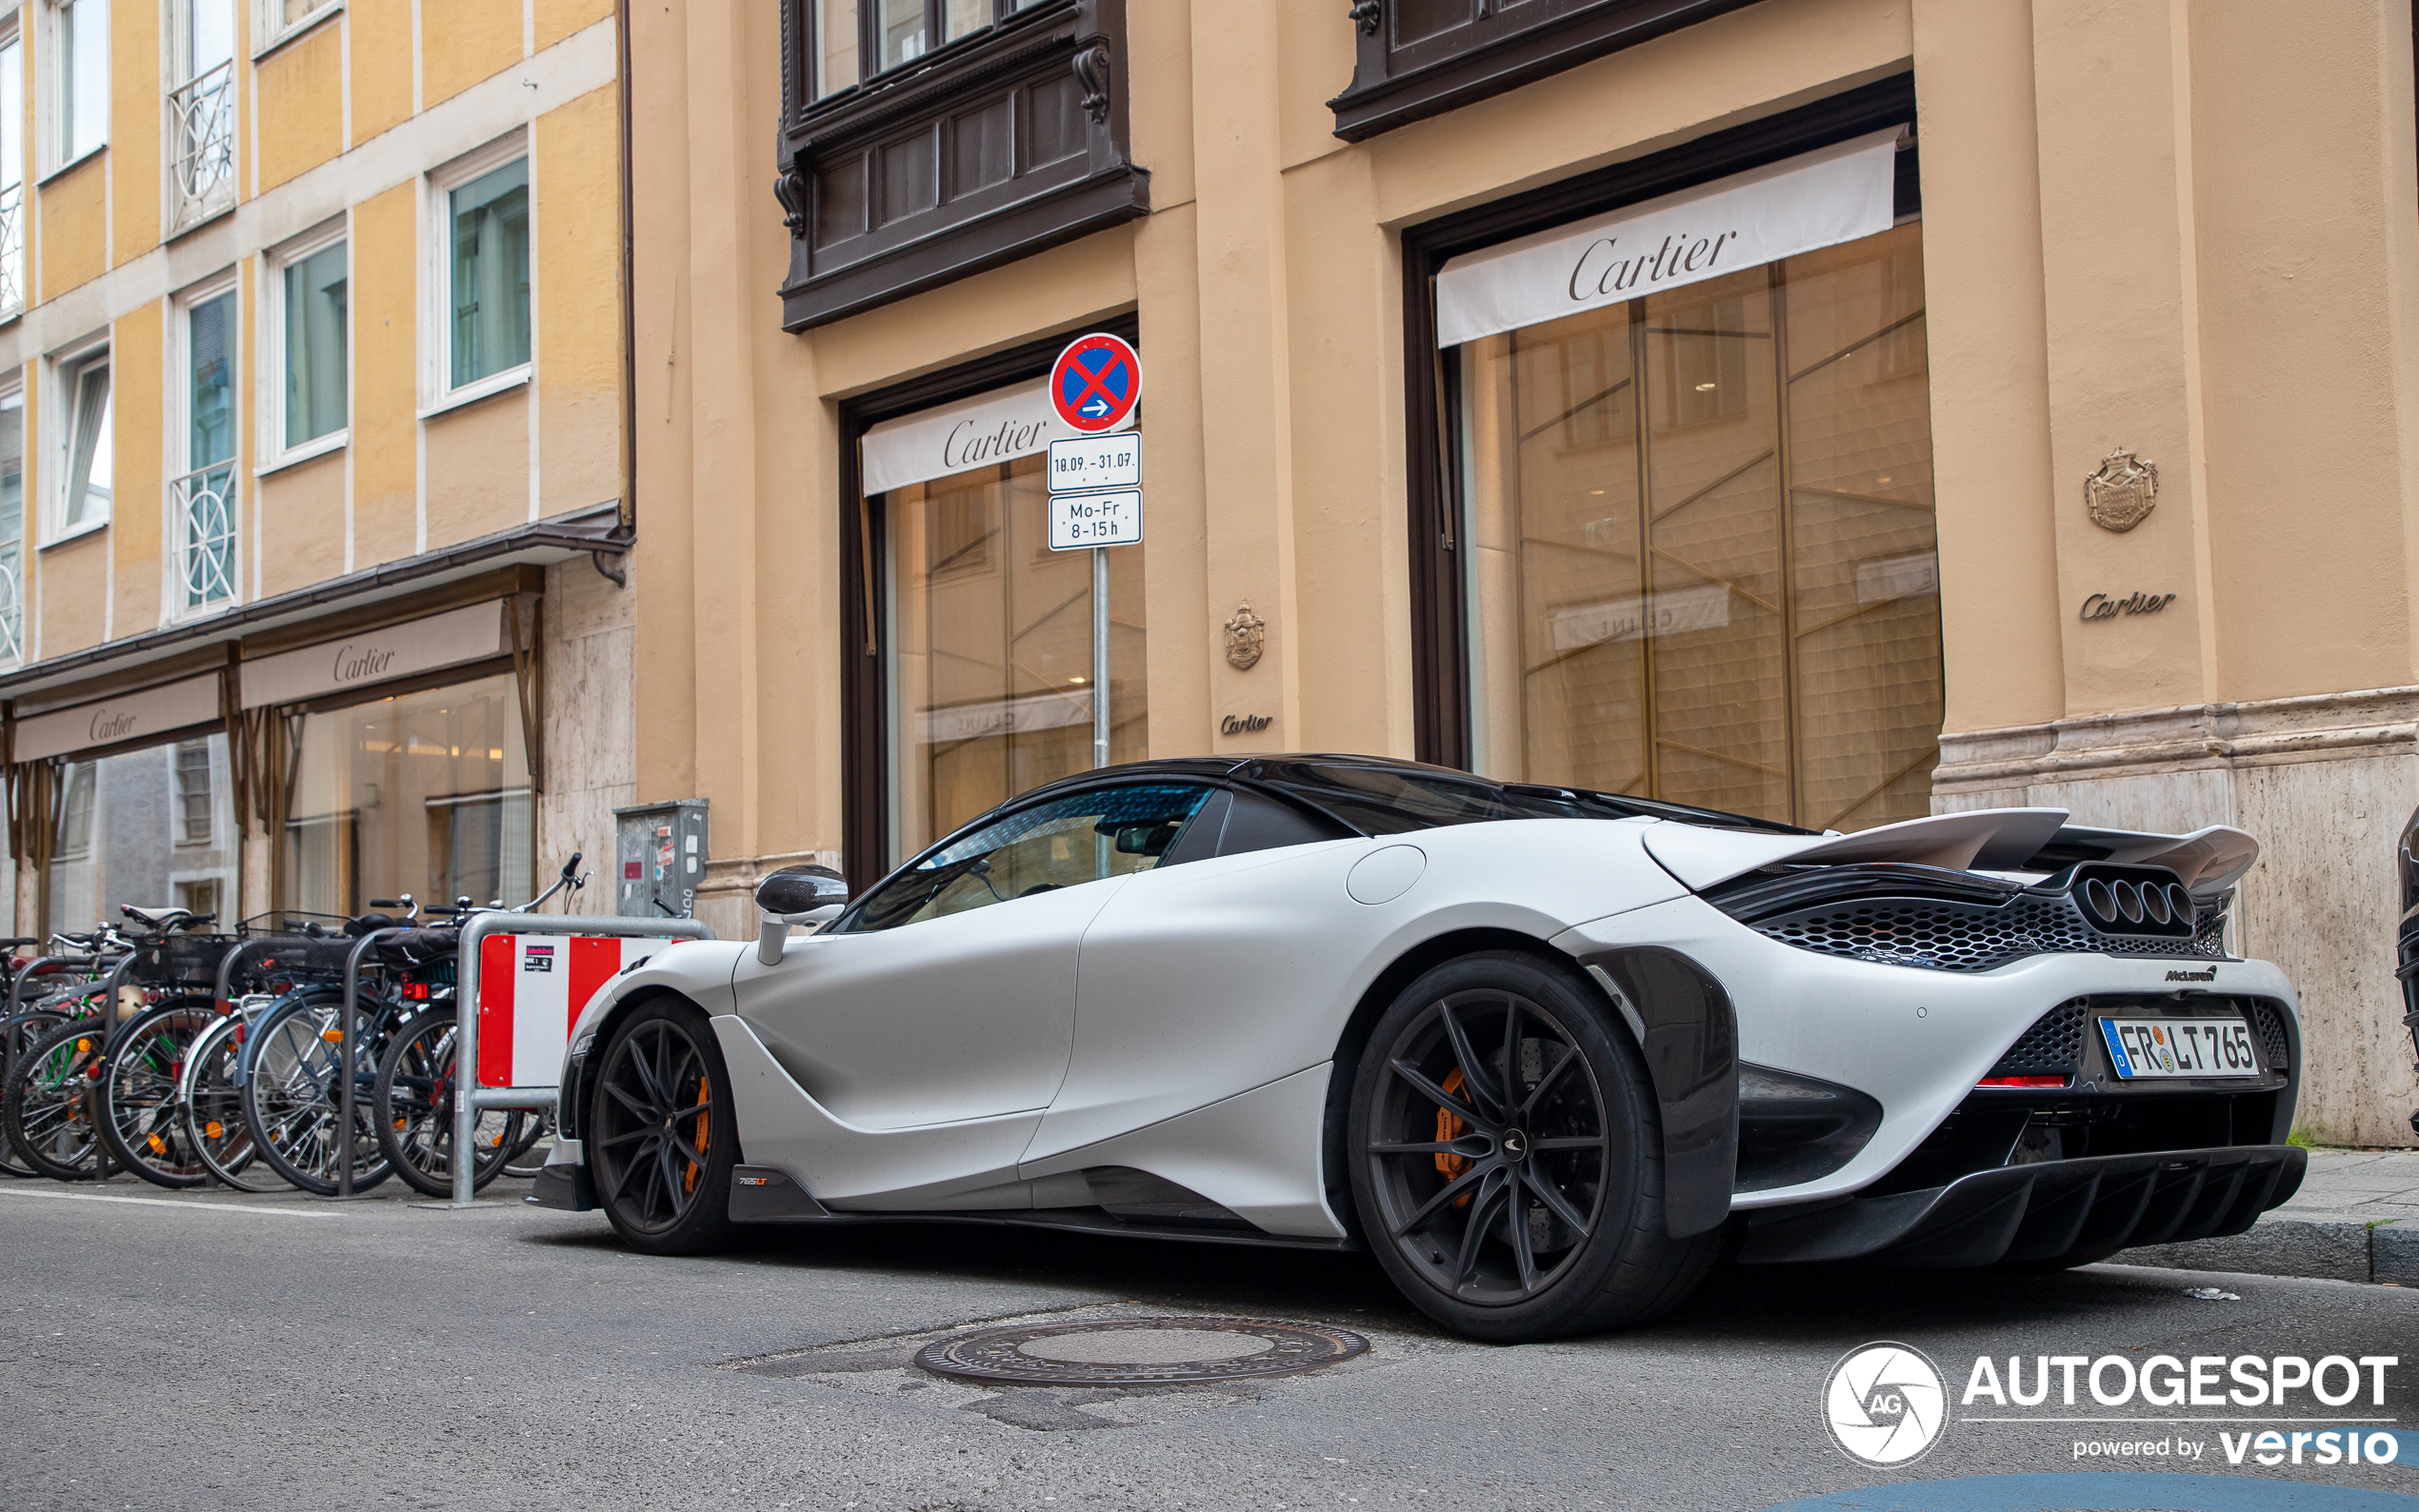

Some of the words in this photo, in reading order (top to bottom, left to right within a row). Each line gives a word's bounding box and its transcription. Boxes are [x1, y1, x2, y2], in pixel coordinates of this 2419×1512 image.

[1569, 229, 1738, 302] Cartier
[944, 419, 1048, 468] Cartier
[1070, 501, 1120, 519] Mo-Fr
[2080, 590, 2177, 620] Cartier
[333, 644, 395, 683] Cartier
[89, 708, 137, 742] Cartier
[1221, 714, 1273, 735] Cartier
[2165, 969, 2216, 983] McLaren
[2117, 1054, 2125, 1067] D
[2119, 1025, 2163, 1070] FR
[2167, 1025, 2204, 1070] LT
[2204, 1025, 2253, 1069] 765
[739, 1177, 768, 1185] 765LT
